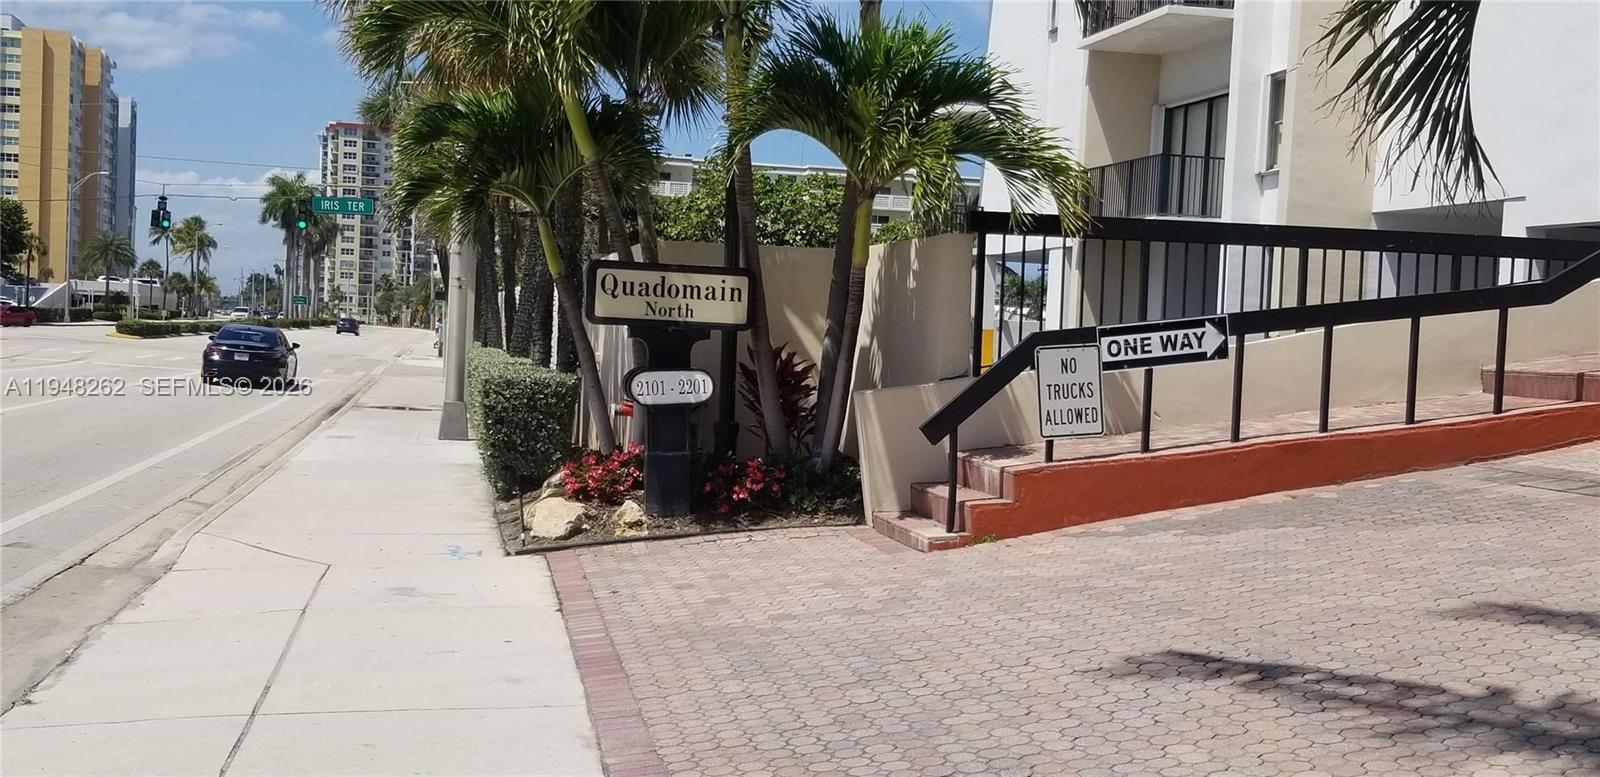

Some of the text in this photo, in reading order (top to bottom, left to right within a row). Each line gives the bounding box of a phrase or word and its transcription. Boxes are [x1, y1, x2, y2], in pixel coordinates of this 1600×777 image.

[321, 200, 365, 211] IRIS TER
[600, 272, 743, 302] Quadomain
[645, 301, 694, 318] North
[1106, 330, 1206, 358] ONE WAY
[1060, 357, 1077, 375] NO
[636, 380, 665, 396] 2101
[678, 378, 707, 395] 2201
[1046, 381, 1094, 400] TRUCKS
[1045, 406, 1098, 426] ALLOWED
